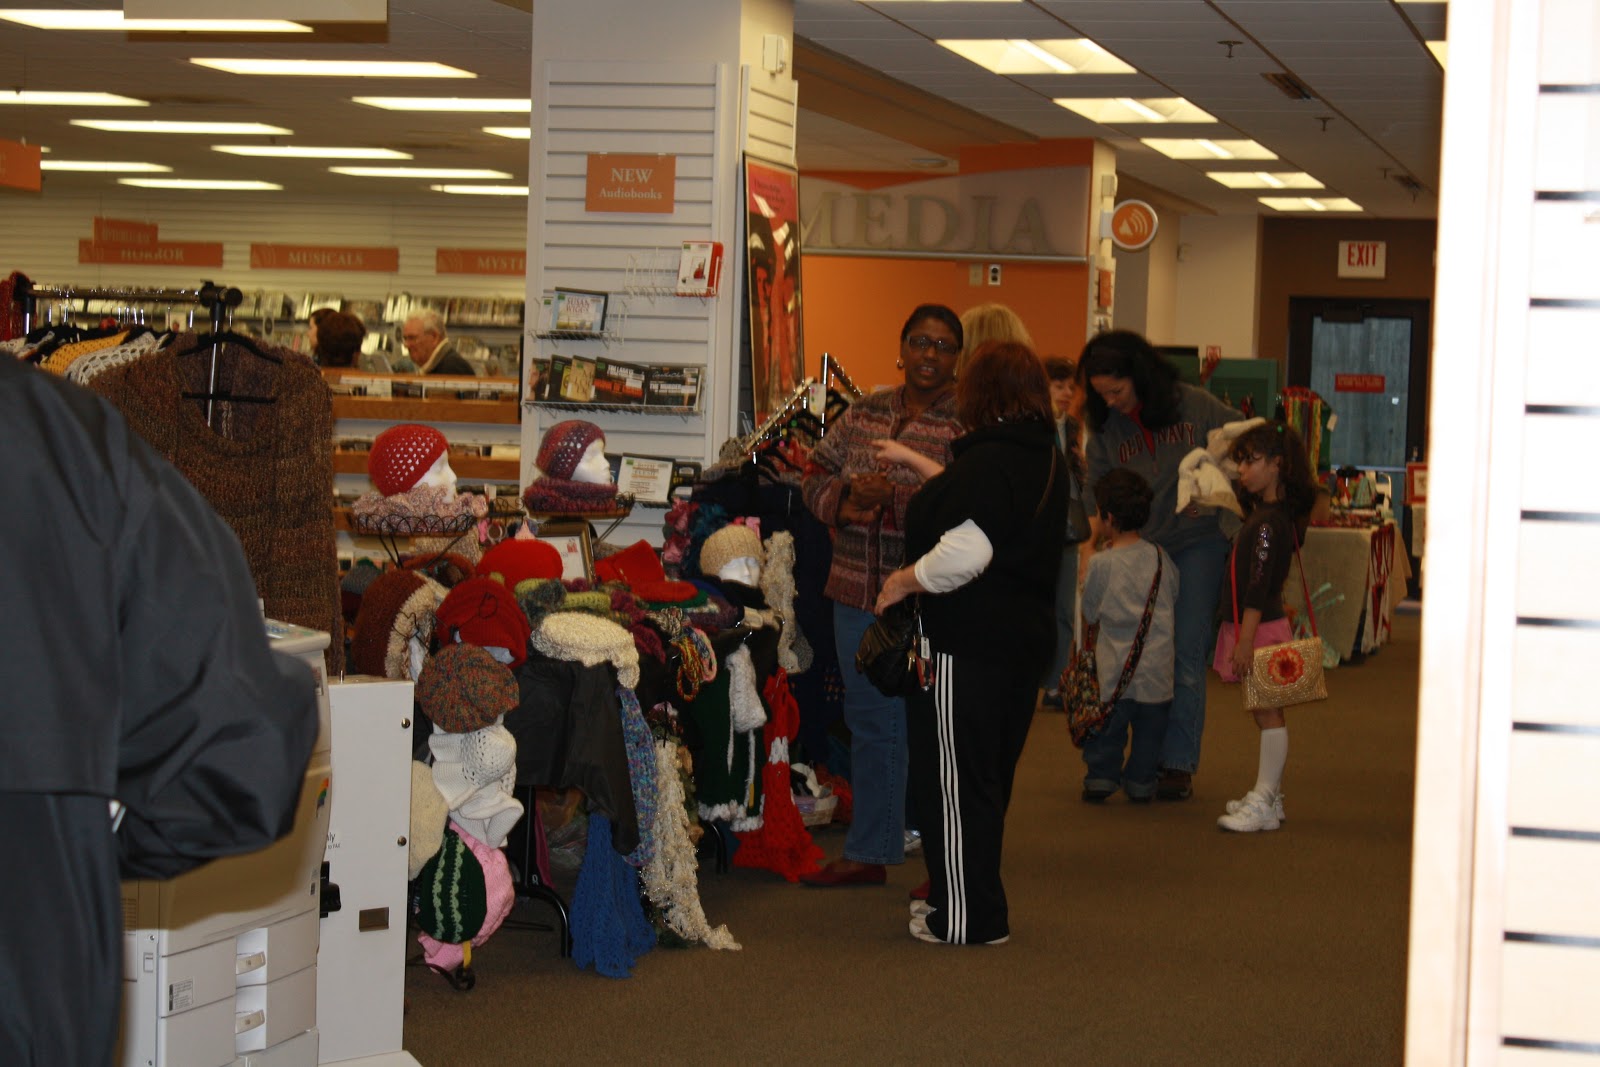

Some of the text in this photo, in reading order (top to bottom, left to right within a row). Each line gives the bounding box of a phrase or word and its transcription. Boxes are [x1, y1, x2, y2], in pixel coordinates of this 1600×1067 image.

[611, 168, 654, 184] NEW
[600, 187, 663, 199] Audiobooks
[799, 191, 1057, 252] MEDIA
[288, 251, 364, 266] MUSICALS
[1347, 243, 1378, 268] EXIT
[1119, 423, 1195, 464] OLD NAVY
